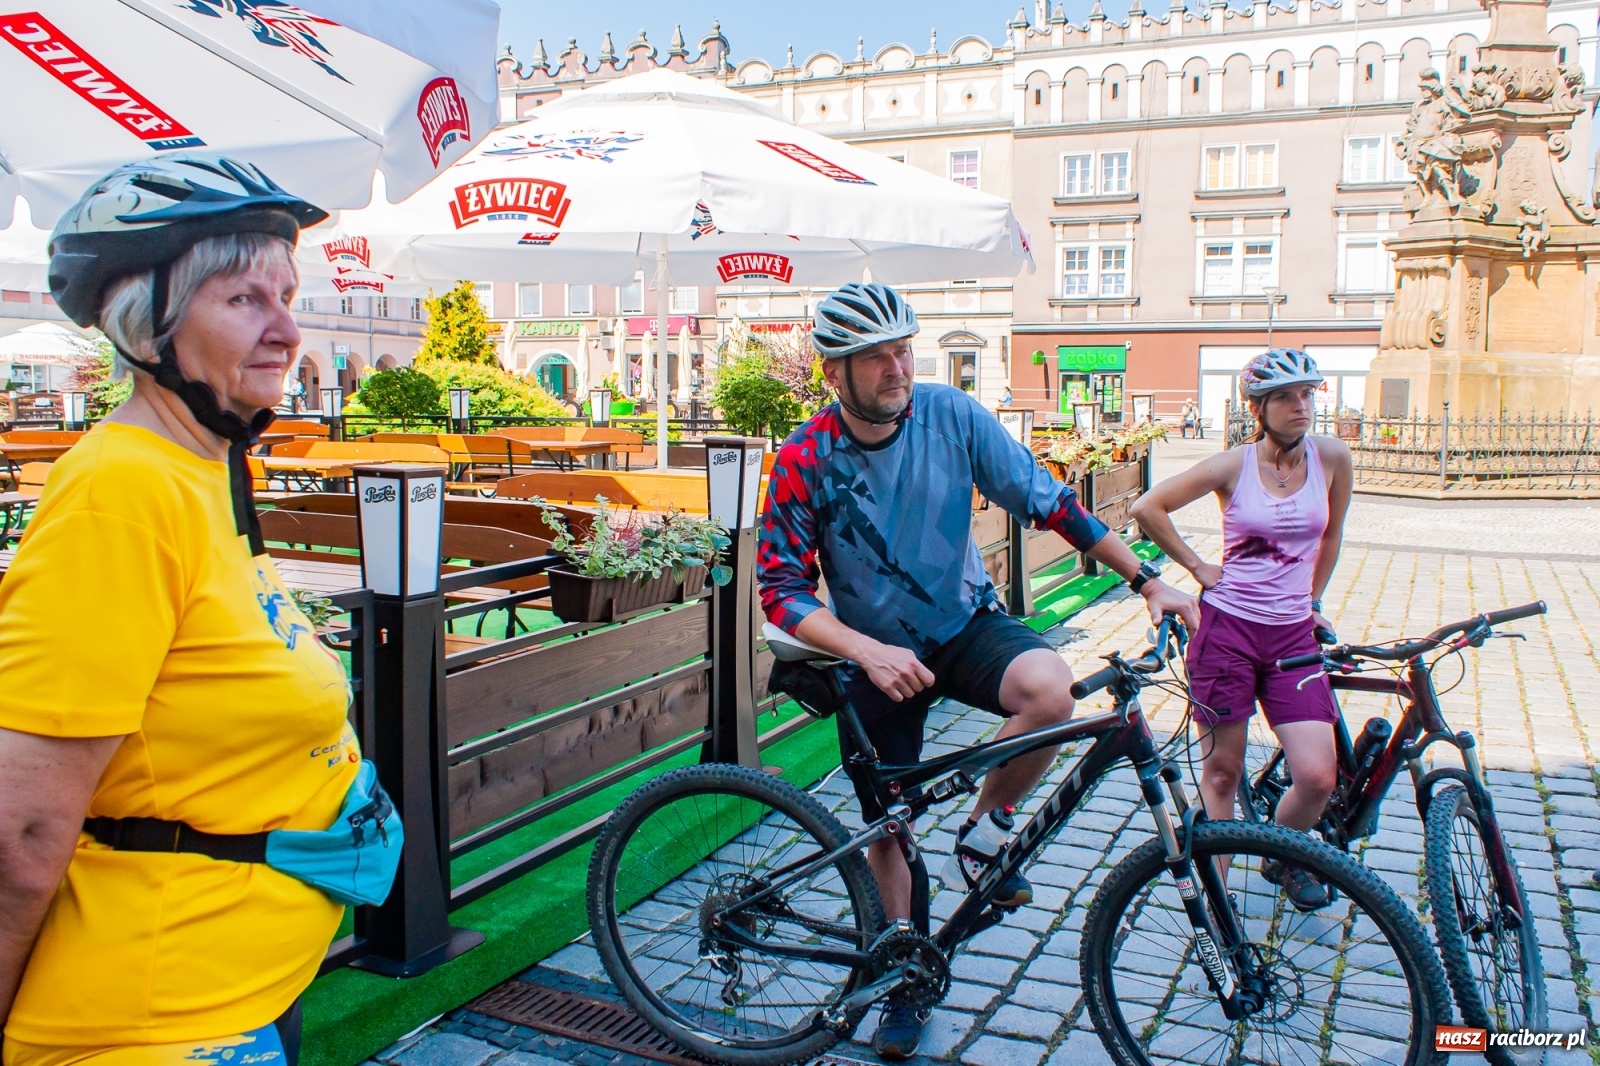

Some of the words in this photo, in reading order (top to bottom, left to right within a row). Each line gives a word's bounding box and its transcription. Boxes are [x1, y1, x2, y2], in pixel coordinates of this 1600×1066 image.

[464, 181, 557, 213] ŻYWIEC
[519, 321, 582, 336] KANTOR
[979, 758, 1087, 893] SCOTT
[1092, 974, 1112, 1029] TOUGH
